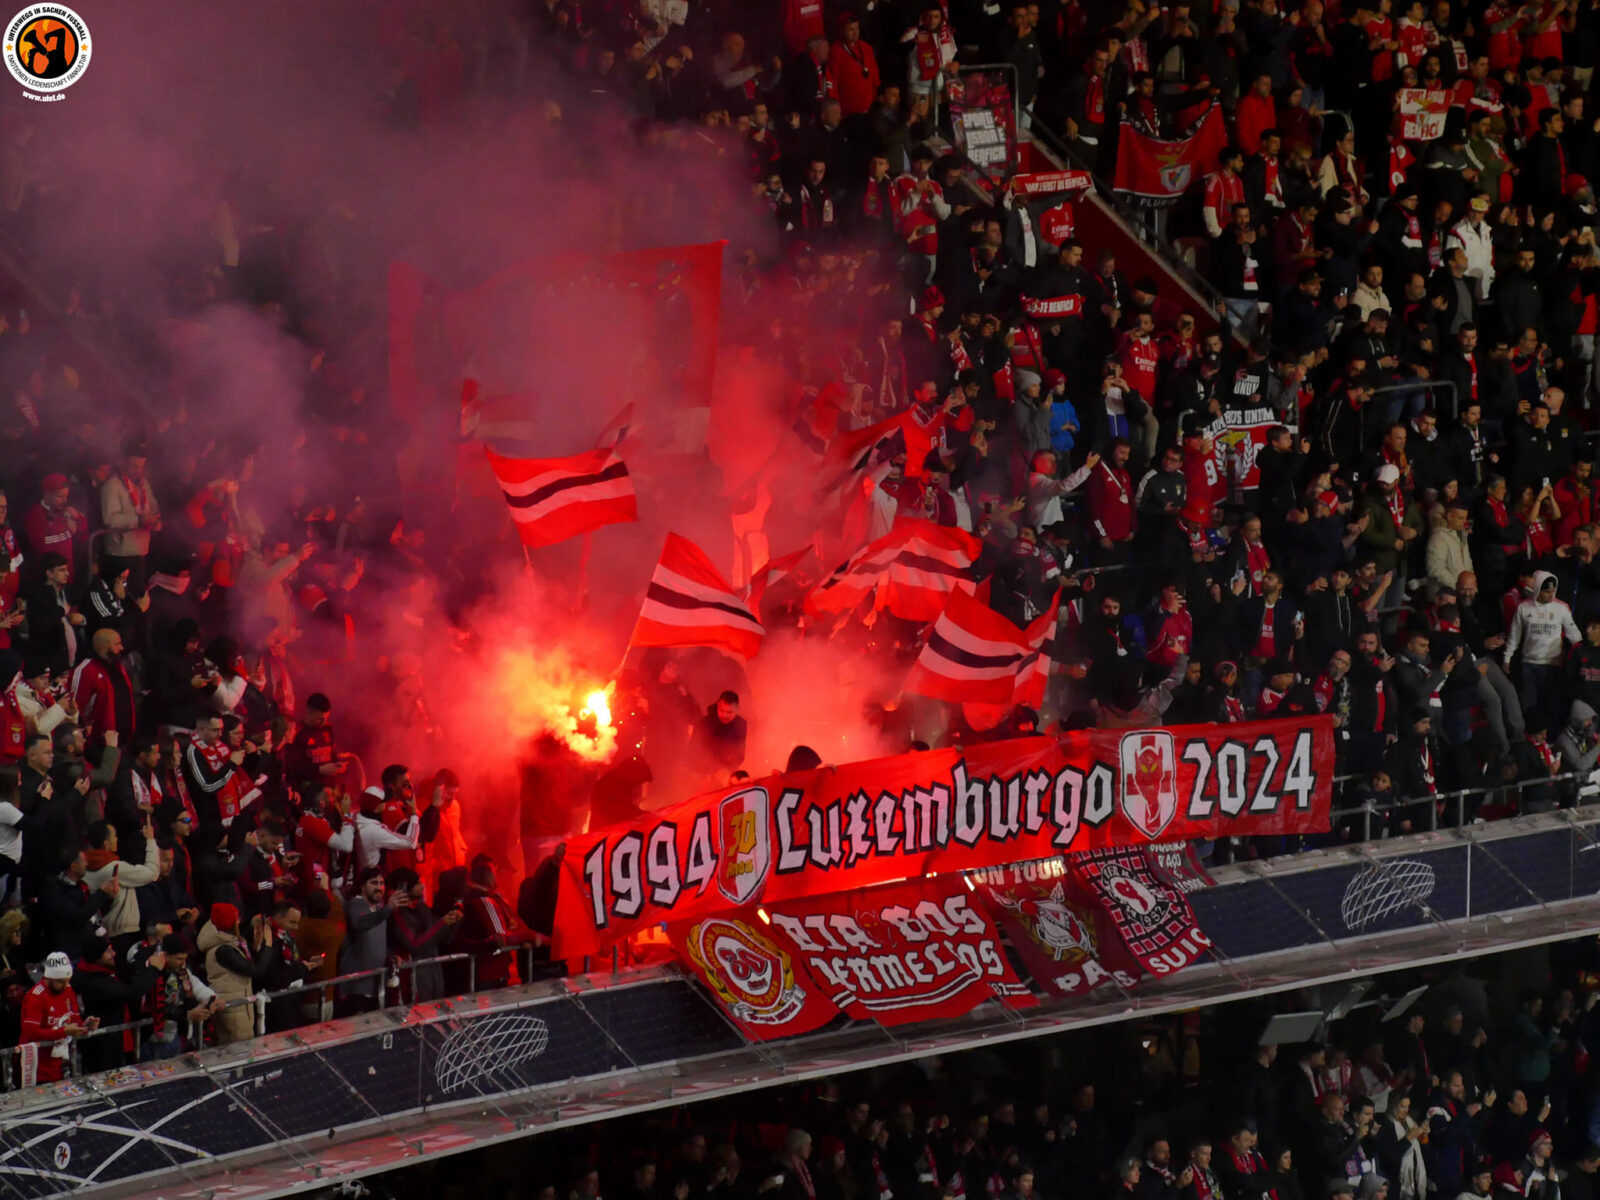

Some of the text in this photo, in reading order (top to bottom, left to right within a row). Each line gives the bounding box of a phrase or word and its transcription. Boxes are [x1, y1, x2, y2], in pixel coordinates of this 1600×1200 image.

[1244, 407, 1275, 424] UNUM
[583, 727, 1317, 930] 1994 Luxemburgo 2024
[726, 811, 757, 857] 30
[1010, 855, 1068, 884] TOUR
